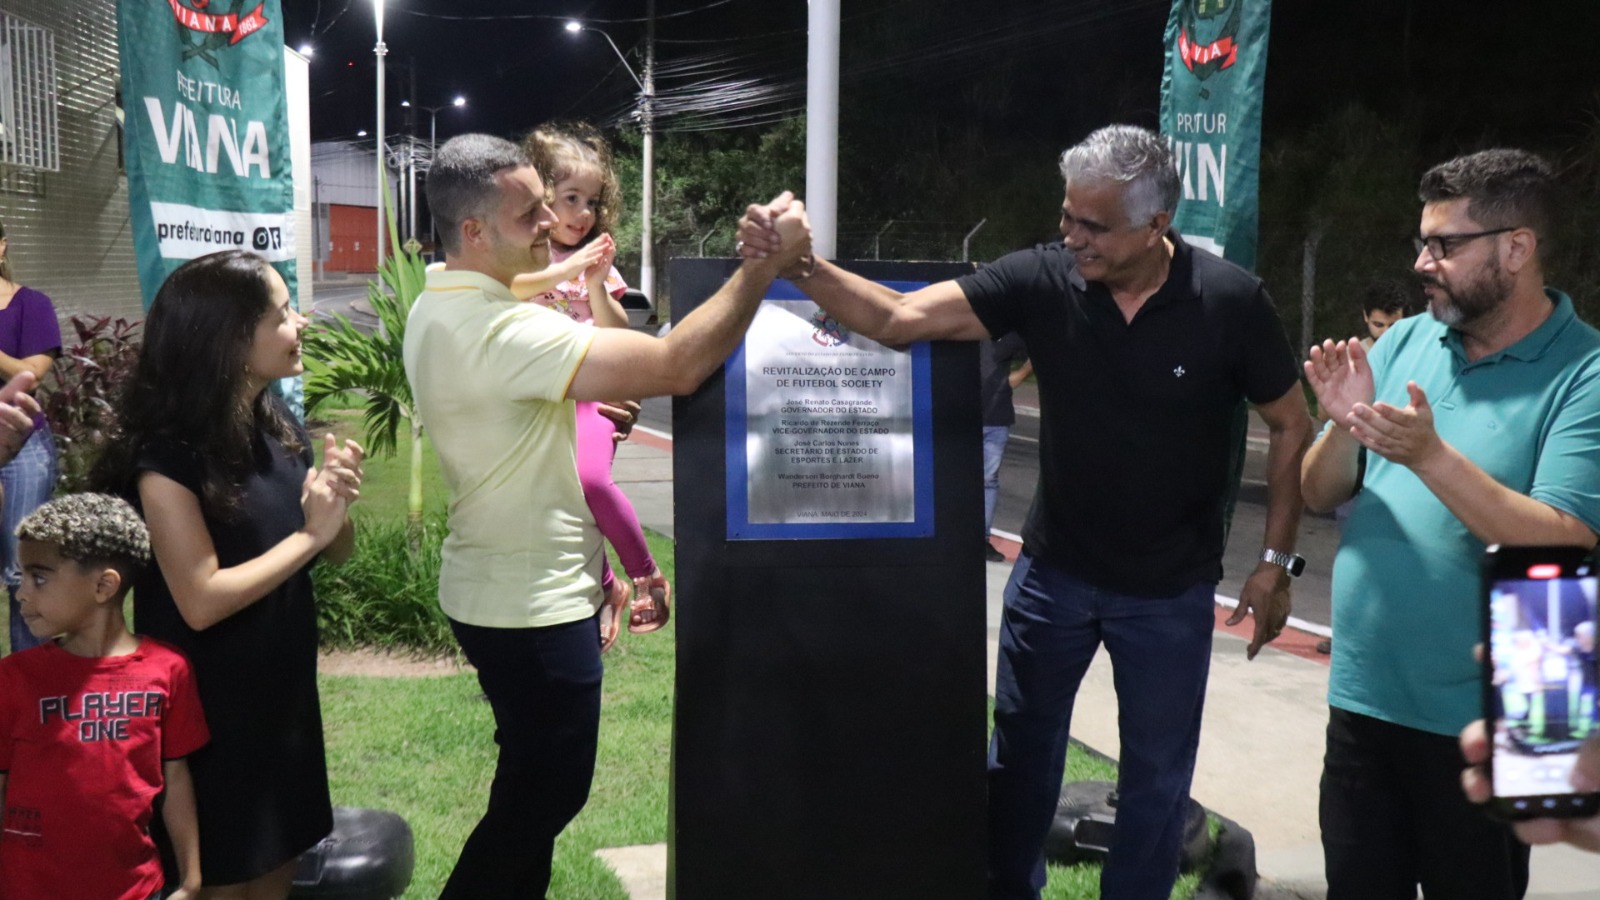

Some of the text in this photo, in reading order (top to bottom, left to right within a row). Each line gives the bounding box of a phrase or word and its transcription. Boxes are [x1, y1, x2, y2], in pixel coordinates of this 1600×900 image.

[762, 366, 896, 377] REVITALIZAÇÃO DE CAMPO
[776, 379, 883, 388] DE FUTEBOL SOCIETY
[786, 398, 873, 407] José Renato Casagrande
[781, 419, 809, 427] Ricardo
[821, 419, 851, 427] Rezende
[772, 427, 890, 435] VICE-GOVERNADOR DO ESTADO
[824, 447, 835, 455] DE
[836, 447, 867, 455] ESTADO
[868, 447, 879, 455] DE
[39, 691, 163, 724] PLAYER
[79, 718, 131, 743] ONE
